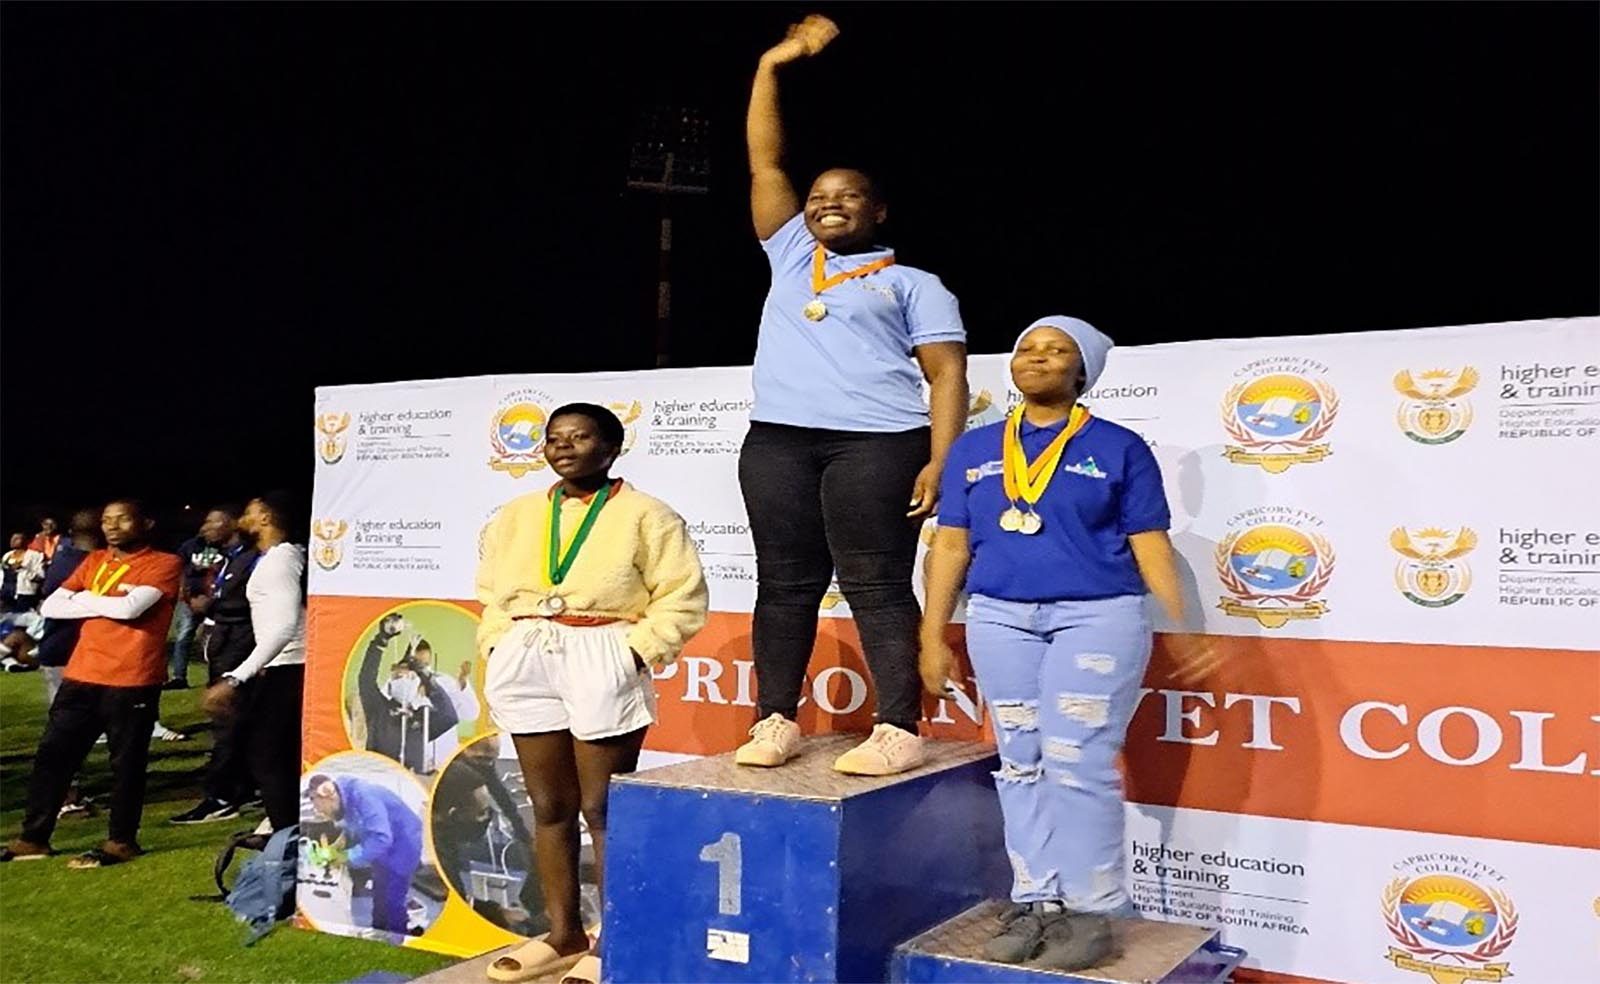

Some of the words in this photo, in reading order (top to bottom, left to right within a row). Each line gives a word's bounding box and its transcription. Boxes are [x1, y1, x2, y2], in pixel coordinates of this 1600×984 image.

[1500, 363, 1576, 385] higher
[1500, 383, 1519, 399] &
[1527, 381, 1600, 398] trainin
[653, 399, 696, 416] higher
[667, 412, 717, 429] training
[388, 518, 441, 530] education
[1500, 528, 1576, 550] higher
[1499, 547, 1519, 564] &
[1527, 549, 1600, 565] trainin
[1340, 701, 1600, 775] COL
[1133, 839, 1195, 864] higher
[1201, 850, 1305, 877] education
[1393, 852, 1468, 870] CAPRICORN
[699, 832, 742, 916] 1
[1133, 858, 1148, 875] &
[1155, 865, 1230, 890] training
[1216, 914, 1258, 928] SOUTH
[1261, 921, 1309, 936] AFRICA
